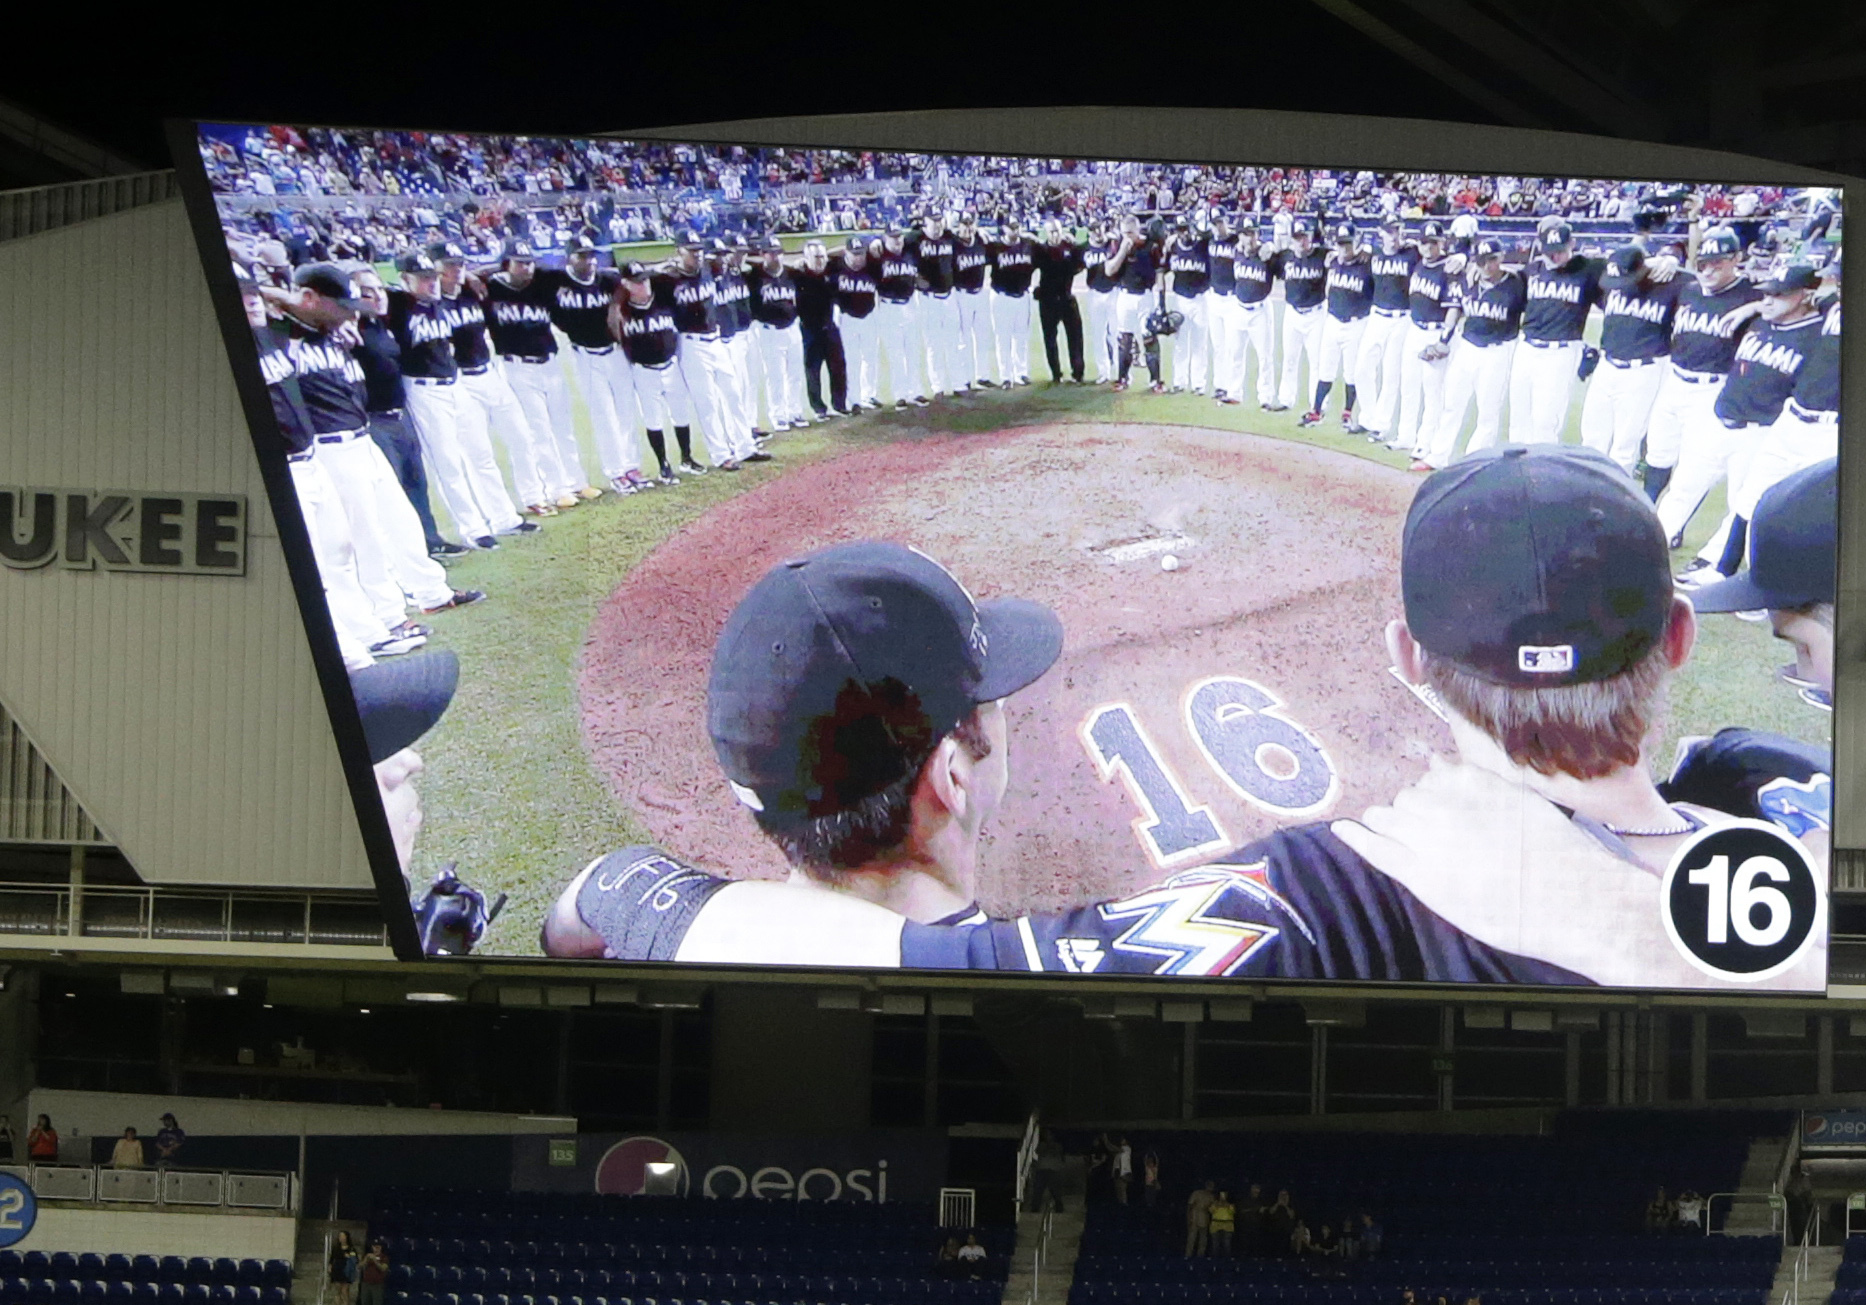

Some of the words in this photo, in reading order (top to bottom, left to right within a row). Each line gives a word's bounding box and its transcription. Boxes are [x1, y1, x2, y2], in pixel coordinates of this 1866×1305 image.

[1461, 297, 1508, 321] MIAMI
[1527, 278, 1580, 304] MIAMI
[1605, 291, 1667, 325] MIAMI
[1735, 330, 1804, 376] MIAMI
[0, 490, 242, 572] UKEE
[1079, 675, 1338, 870] 16
[1688, 854, 1792, 946] 16
[551, 1149, 574, 1162] 135
